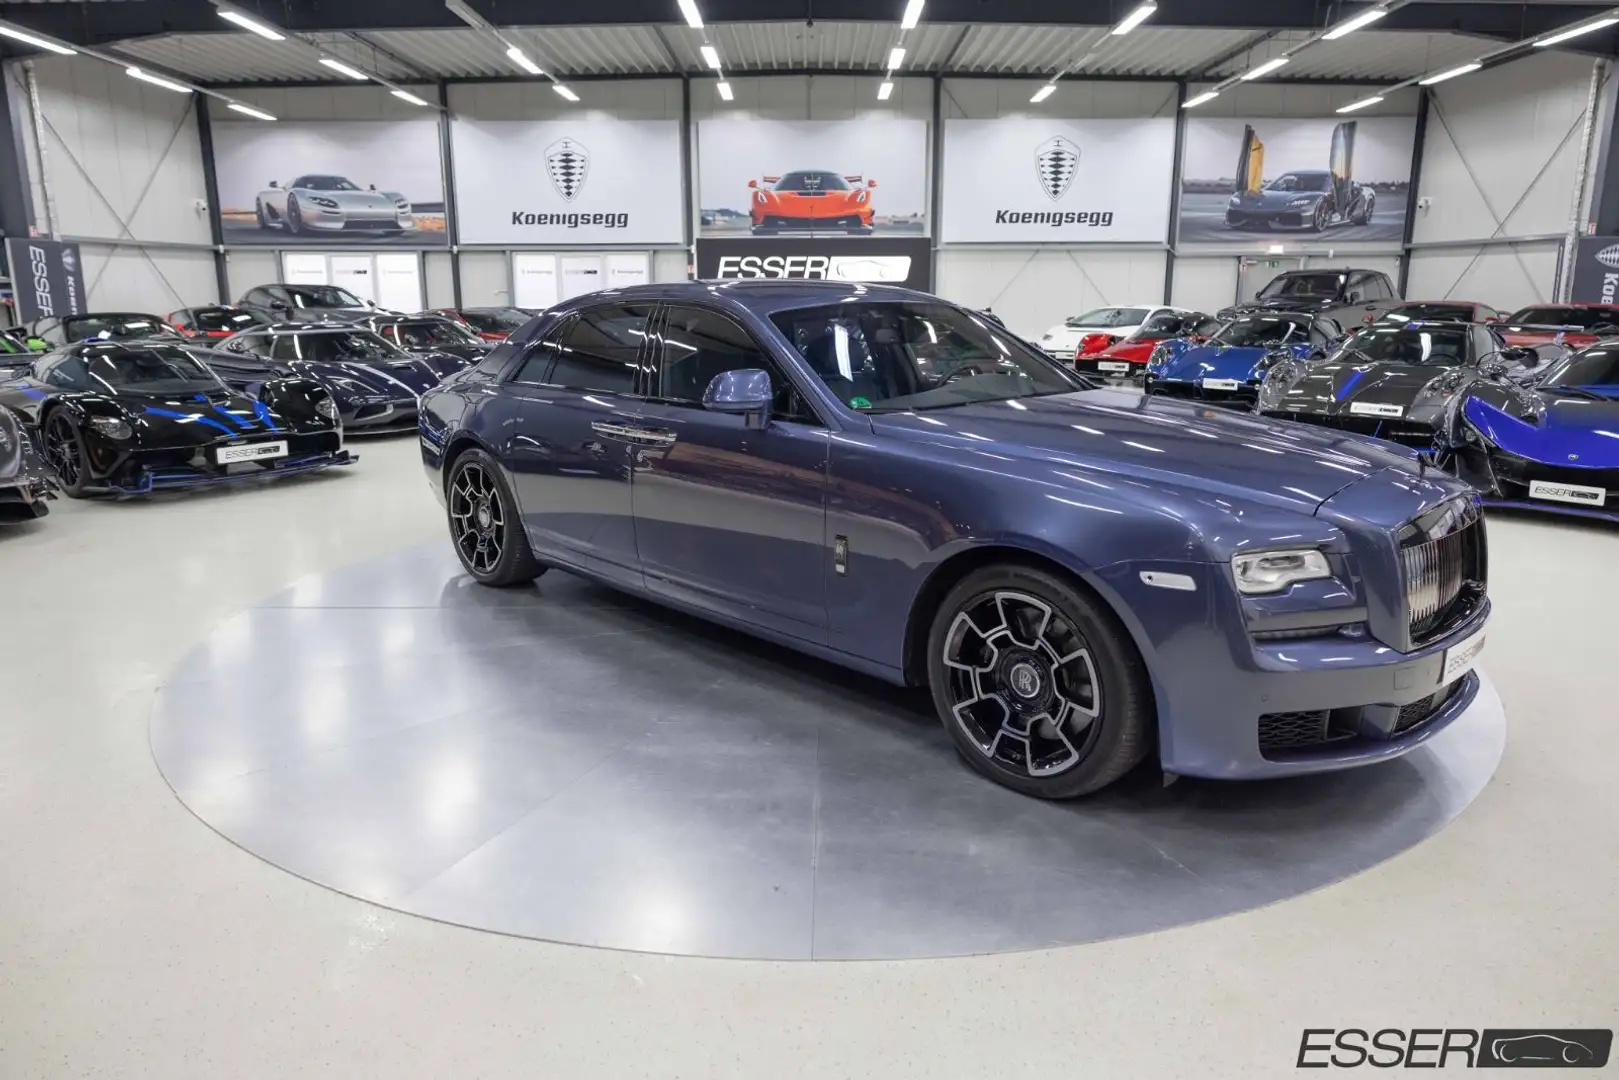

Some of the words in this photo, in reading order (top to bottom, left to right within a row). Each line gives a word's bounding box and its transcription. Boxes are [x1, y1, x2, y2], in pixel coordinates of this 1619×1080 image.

[511, 211, 629, 228] Koenigsegg
[995, 209, 1114, 227] Koenigsegg
[1534, 481, 1572, 497] ESSER
